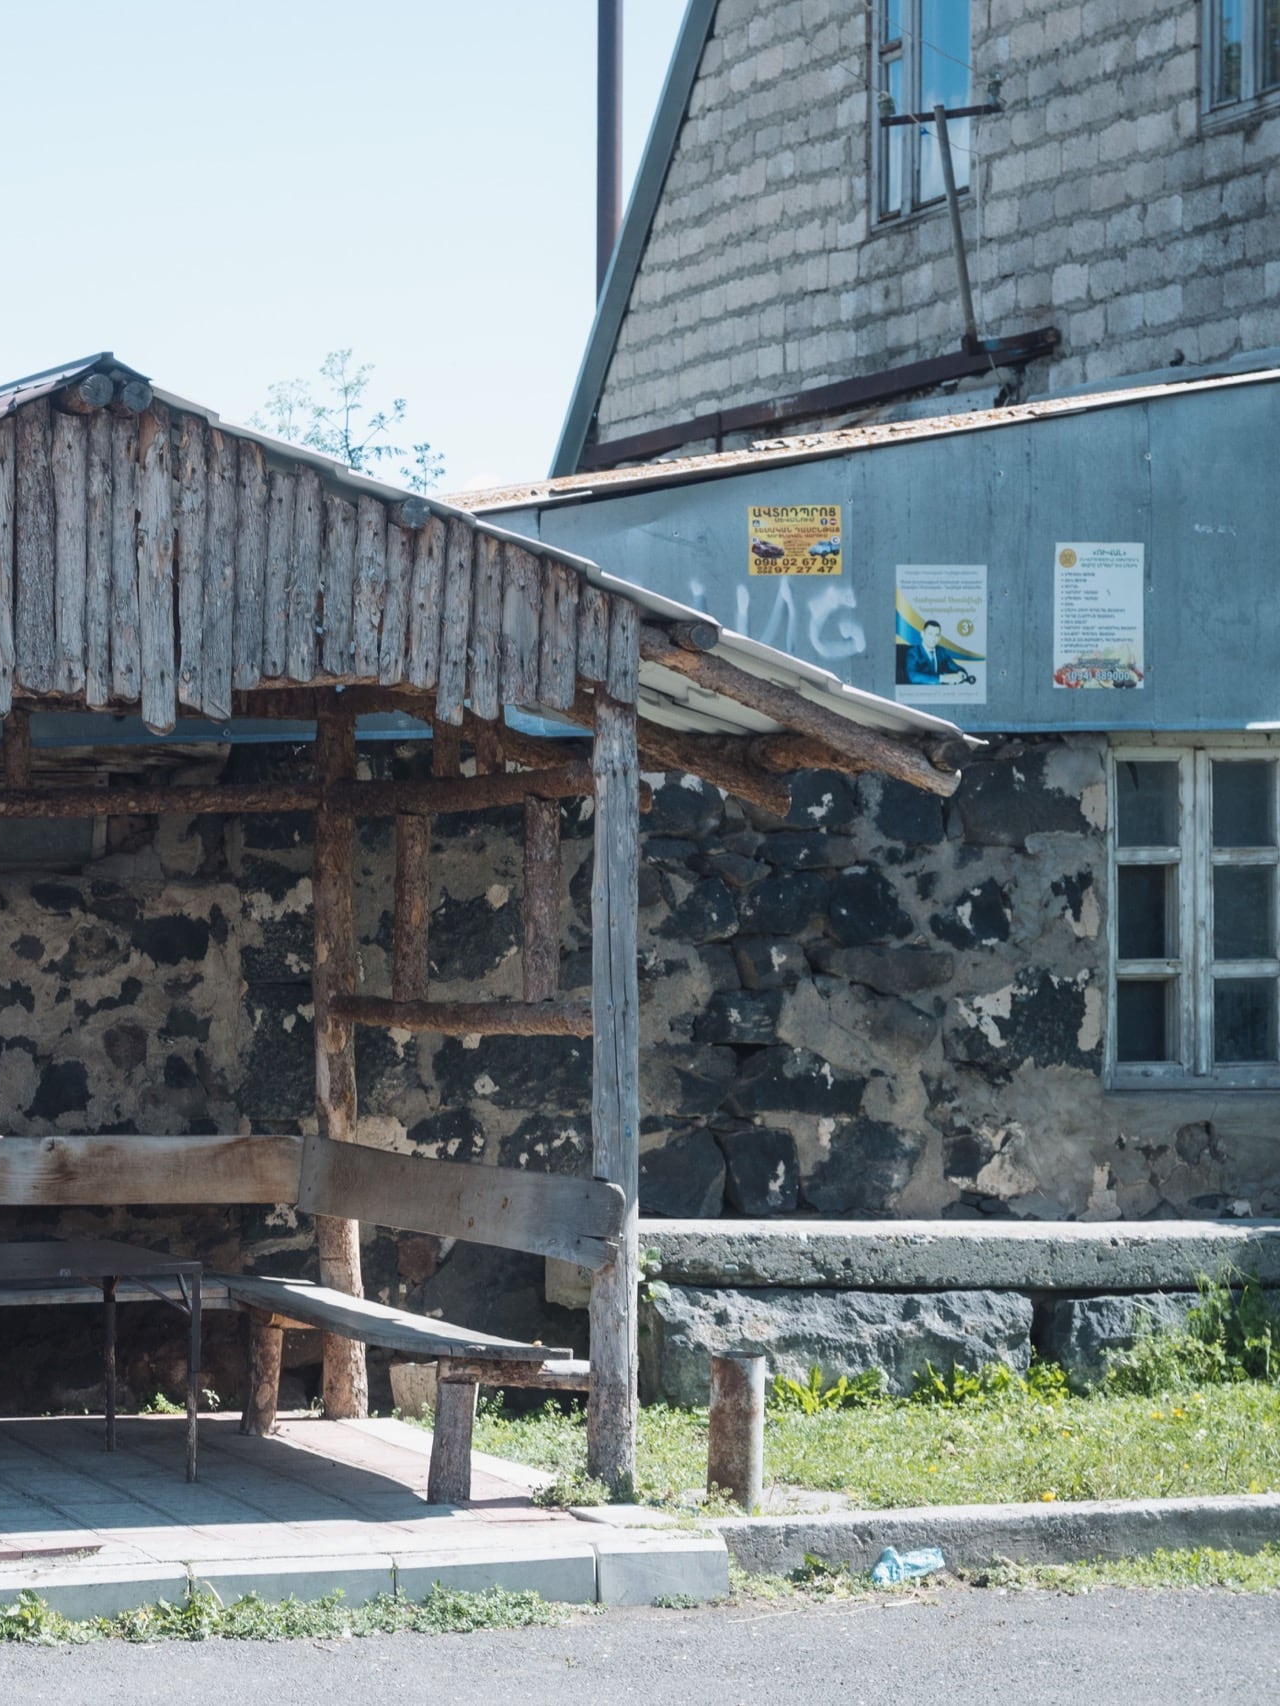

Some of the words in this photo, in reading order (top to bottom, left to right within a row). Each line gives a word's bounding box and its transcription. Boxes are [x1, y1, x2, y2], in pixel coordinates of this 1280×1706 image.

[753, 507, 836, 517] ԱՎՏՈԴՊՐՈՑ
[754, 558, 777, 566] 098
[782, 558, 797, 566] 02
[802, 558, 817, 566] 67
[822, 558, 837, 566] 09
